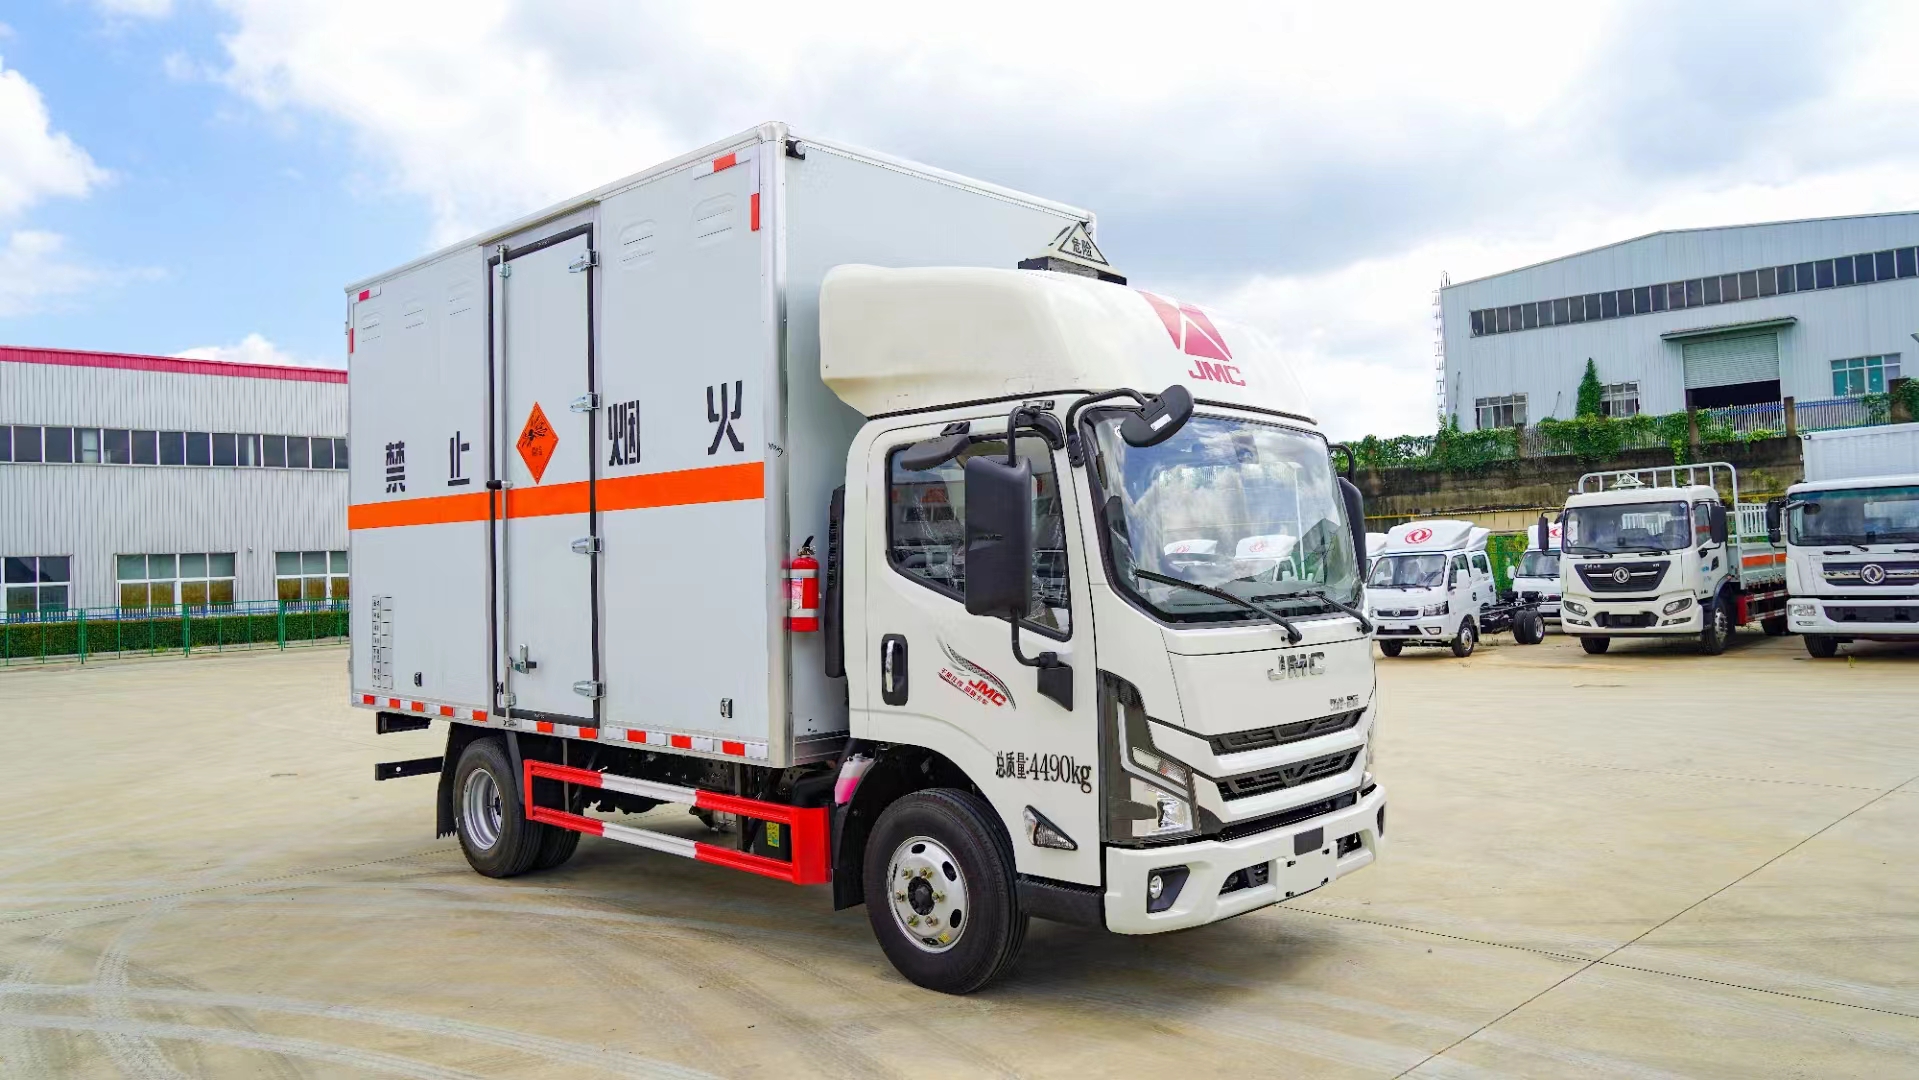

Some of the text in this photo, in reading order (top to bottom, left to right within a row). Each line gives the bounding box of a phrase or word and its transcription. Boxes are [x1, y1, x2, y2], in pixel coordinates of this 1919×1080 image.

[1071, 236, 1092, 257] 危险
[1188, 359, 1246, 386] JMC
[386, 380, 745, 494] 禁止烟火
[1267, 651, 1325, 681] JMC
[968, 679, 1007, 707] JMC
